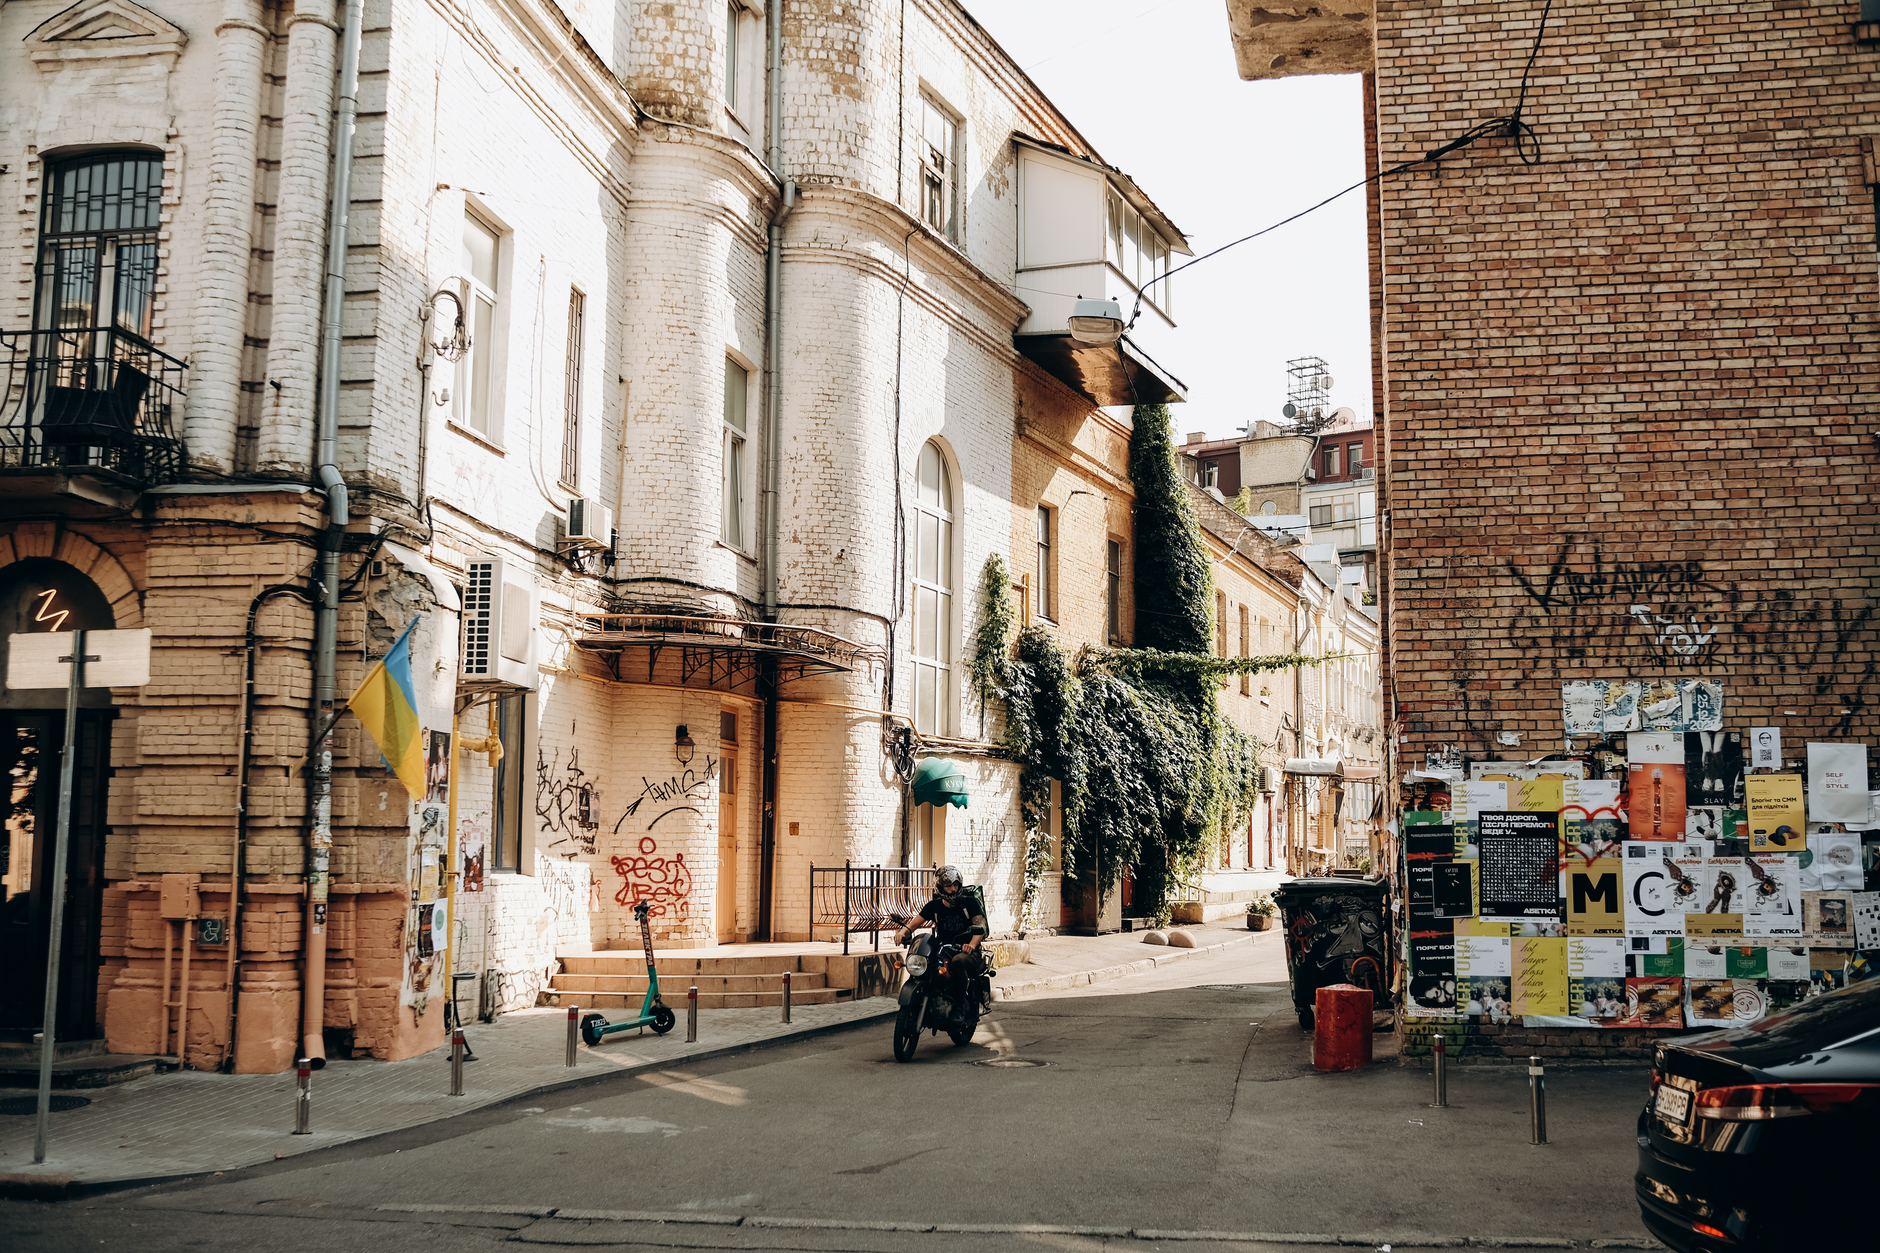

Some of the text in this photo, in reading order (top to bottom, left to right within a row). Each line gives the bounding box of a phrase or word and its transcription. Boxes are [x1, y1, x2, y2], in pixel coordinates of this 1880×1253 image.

[1516, 783, 1534, 796] hot
[1518, 796, 1544, 808] dance
[1453, 784, 1468, 857] VERTUHA
[1520, 939, 1538, 952] hot
[1521, 951, 1547, 964] dance
[1456, 938, 1471, 1013] VERTUHA
[1521, 974, 1544, 986] disco
[1570, 939, 1585, 1014] VERTUHA
[1516, 988, 1547, 1004] party
